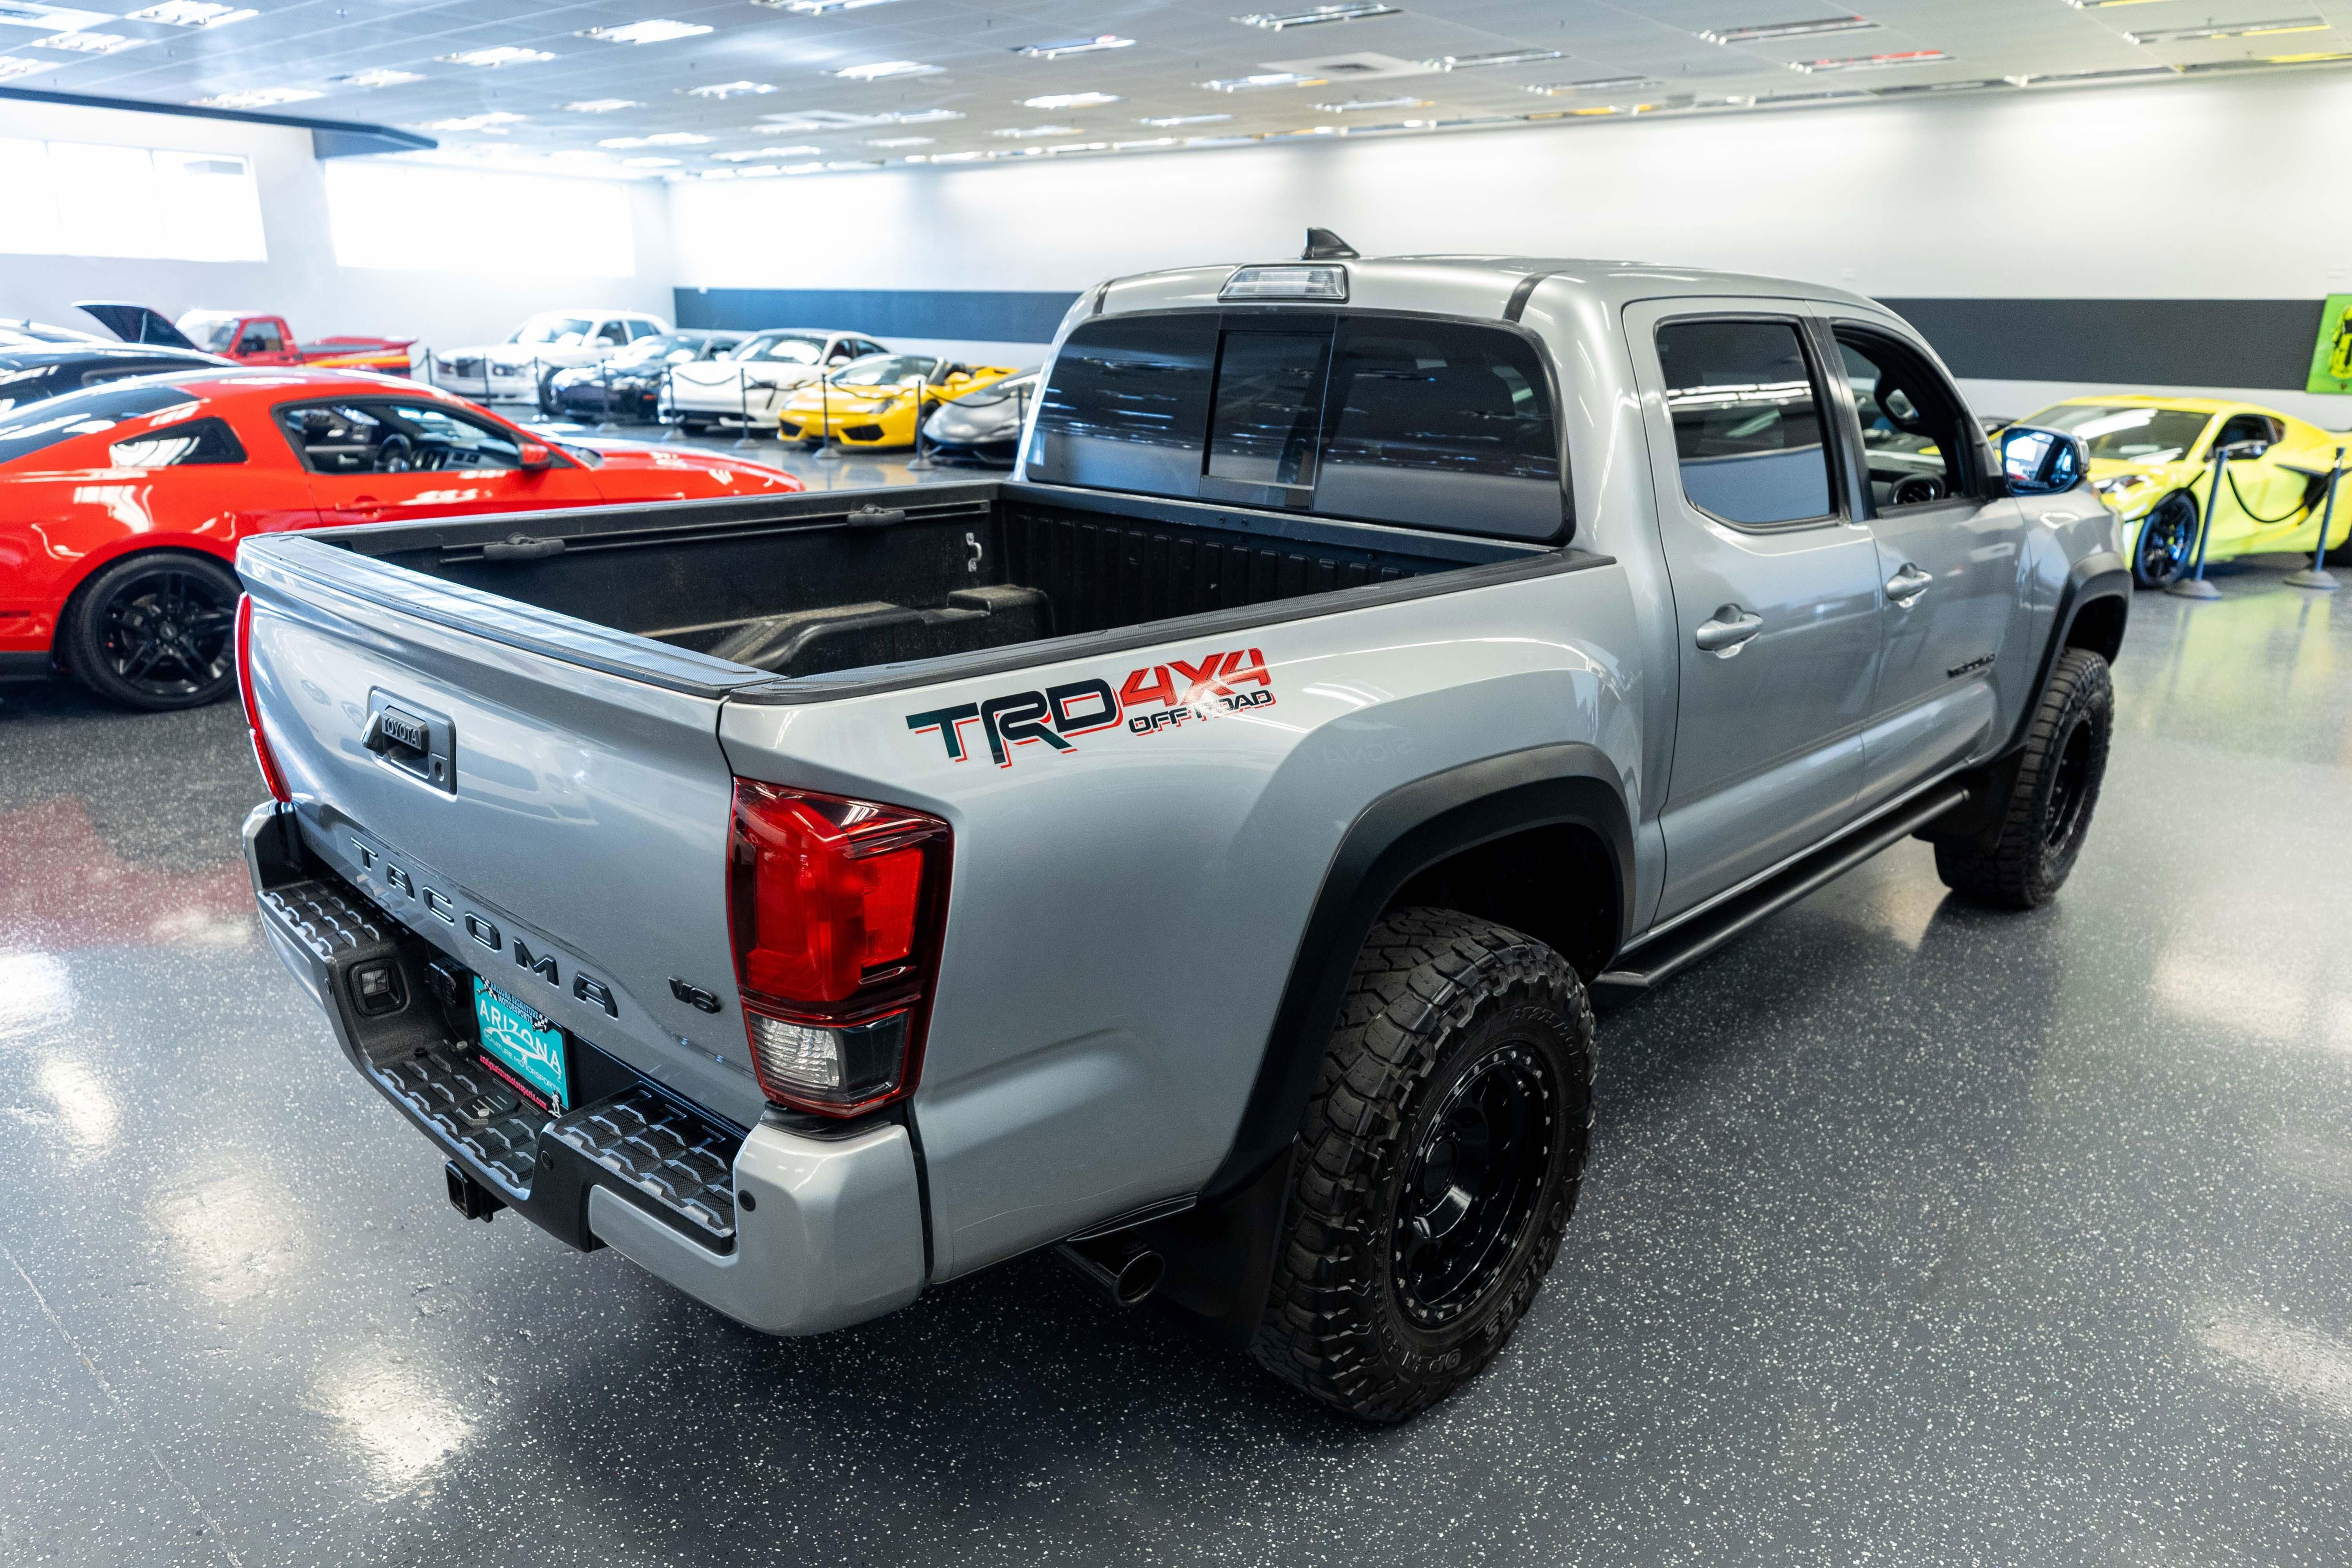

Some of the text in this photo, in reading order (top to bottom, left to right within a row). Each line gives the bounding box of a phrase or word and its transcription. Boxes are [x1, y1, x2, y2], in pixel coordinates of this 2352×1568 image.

[383, 717, 421, 748] TOYOTA
[905, 678, 1123, 768] TRD
[1128, 707, 1192, 736] OFF
[351, 837, 619, 1020] TACOMA
[490, 982, 539, 1020] ARIZONA SIGNATURE
[498, 994, 533, 1024] MOTORSPORTS
[668, 976, 721, 1014] V6
[480, 999, 562, 1074] ARIZONA
[483, 1031, 513, 1060] SIGNATURE
[480, 1055, 548, 1111] azsignaturemotorsports.com
